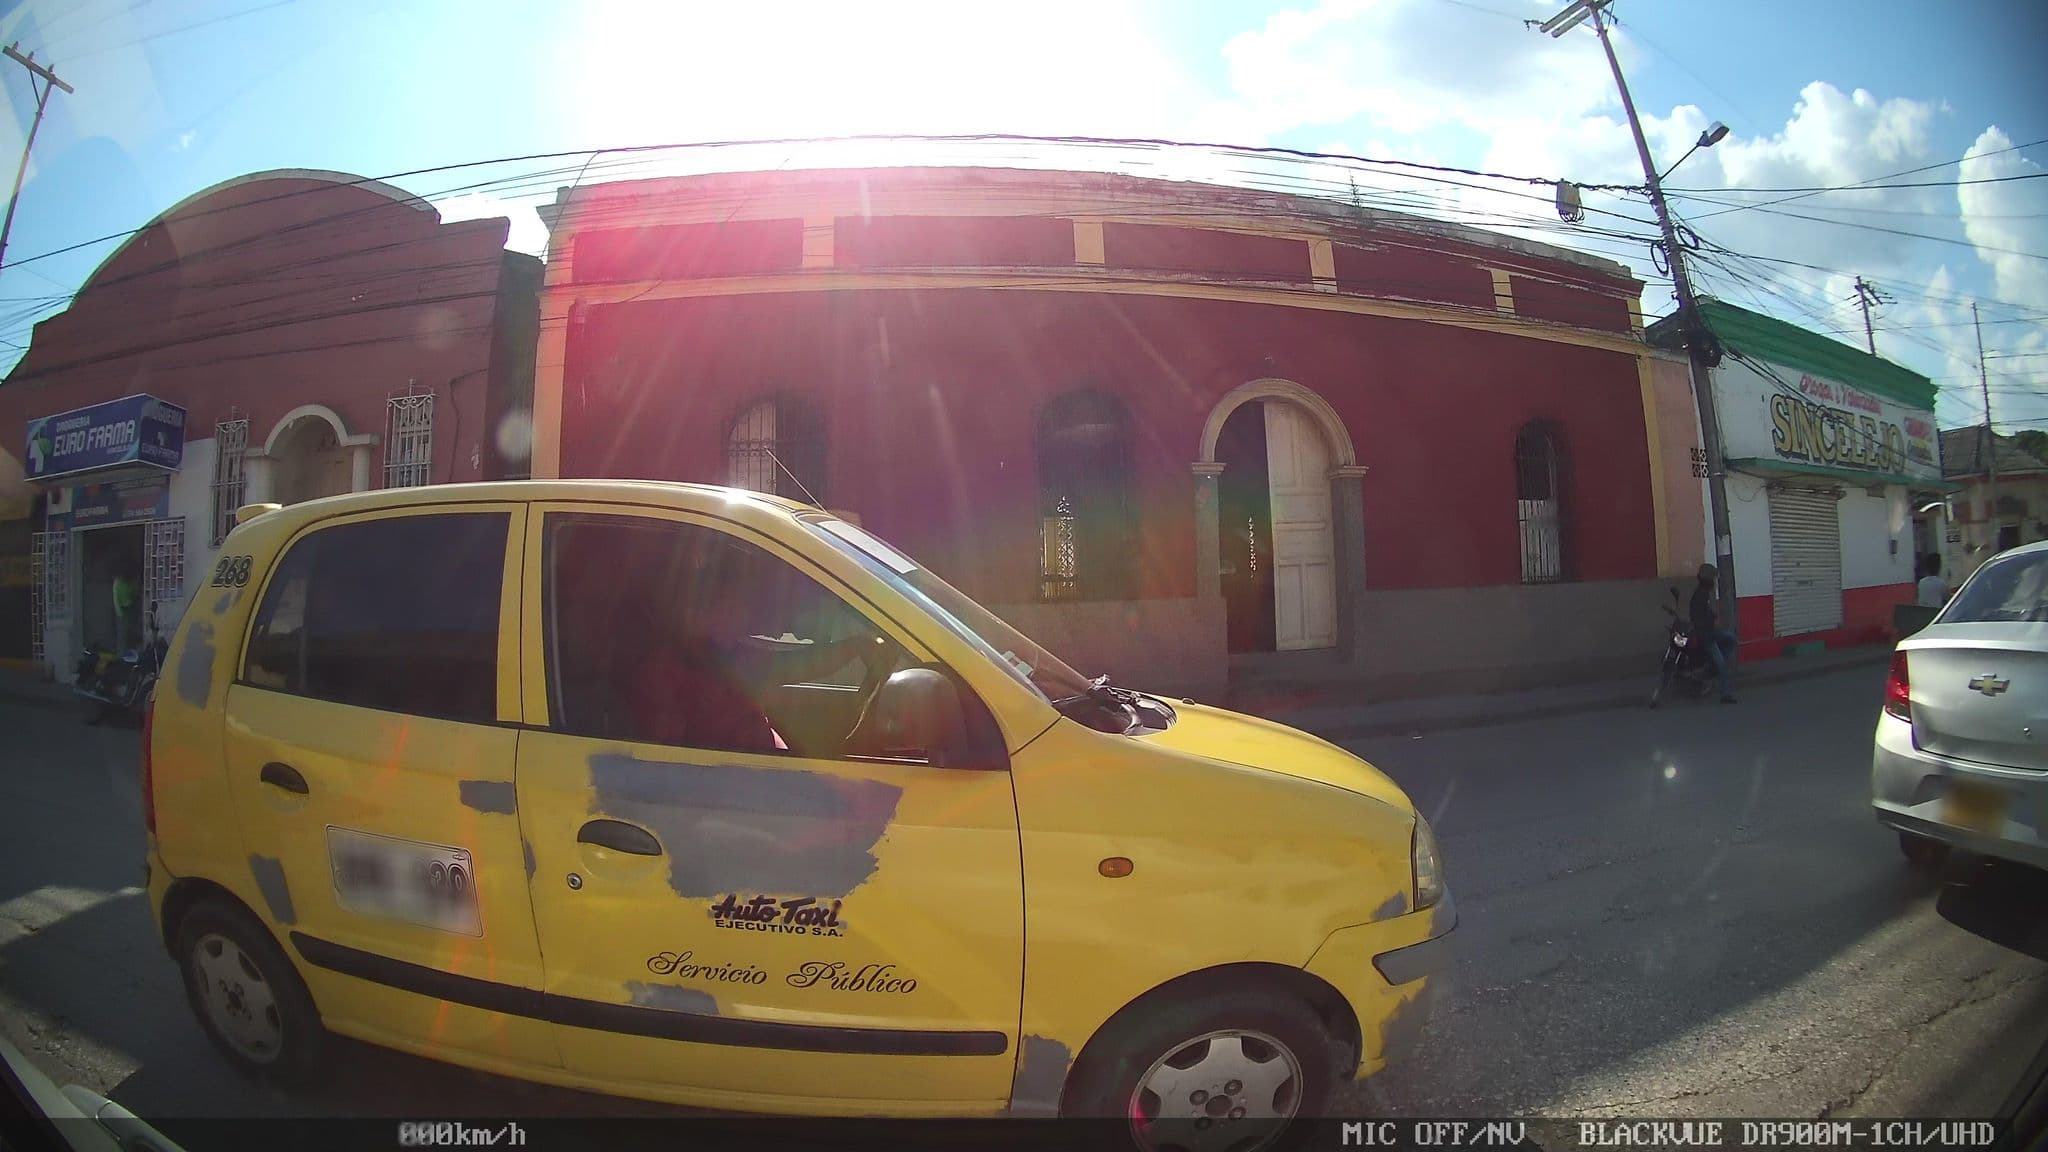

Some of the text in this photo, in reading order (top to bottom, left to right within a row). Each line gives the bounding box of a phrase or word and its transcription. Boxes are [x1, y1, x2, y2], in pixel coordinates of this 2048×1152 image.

[53, 431, 86, 457] EURO
[86, 419, 137, 451] FARMA
[1770, 393, 1905, 473] SINCELEJO
[211, 555, 255, 588] 268
[711, 894, 843, 928] Auto Taxi
[715, 919, 843, 938] EJECUTIVO S.A.
[646, 951, 918, 994] Servicio Público
